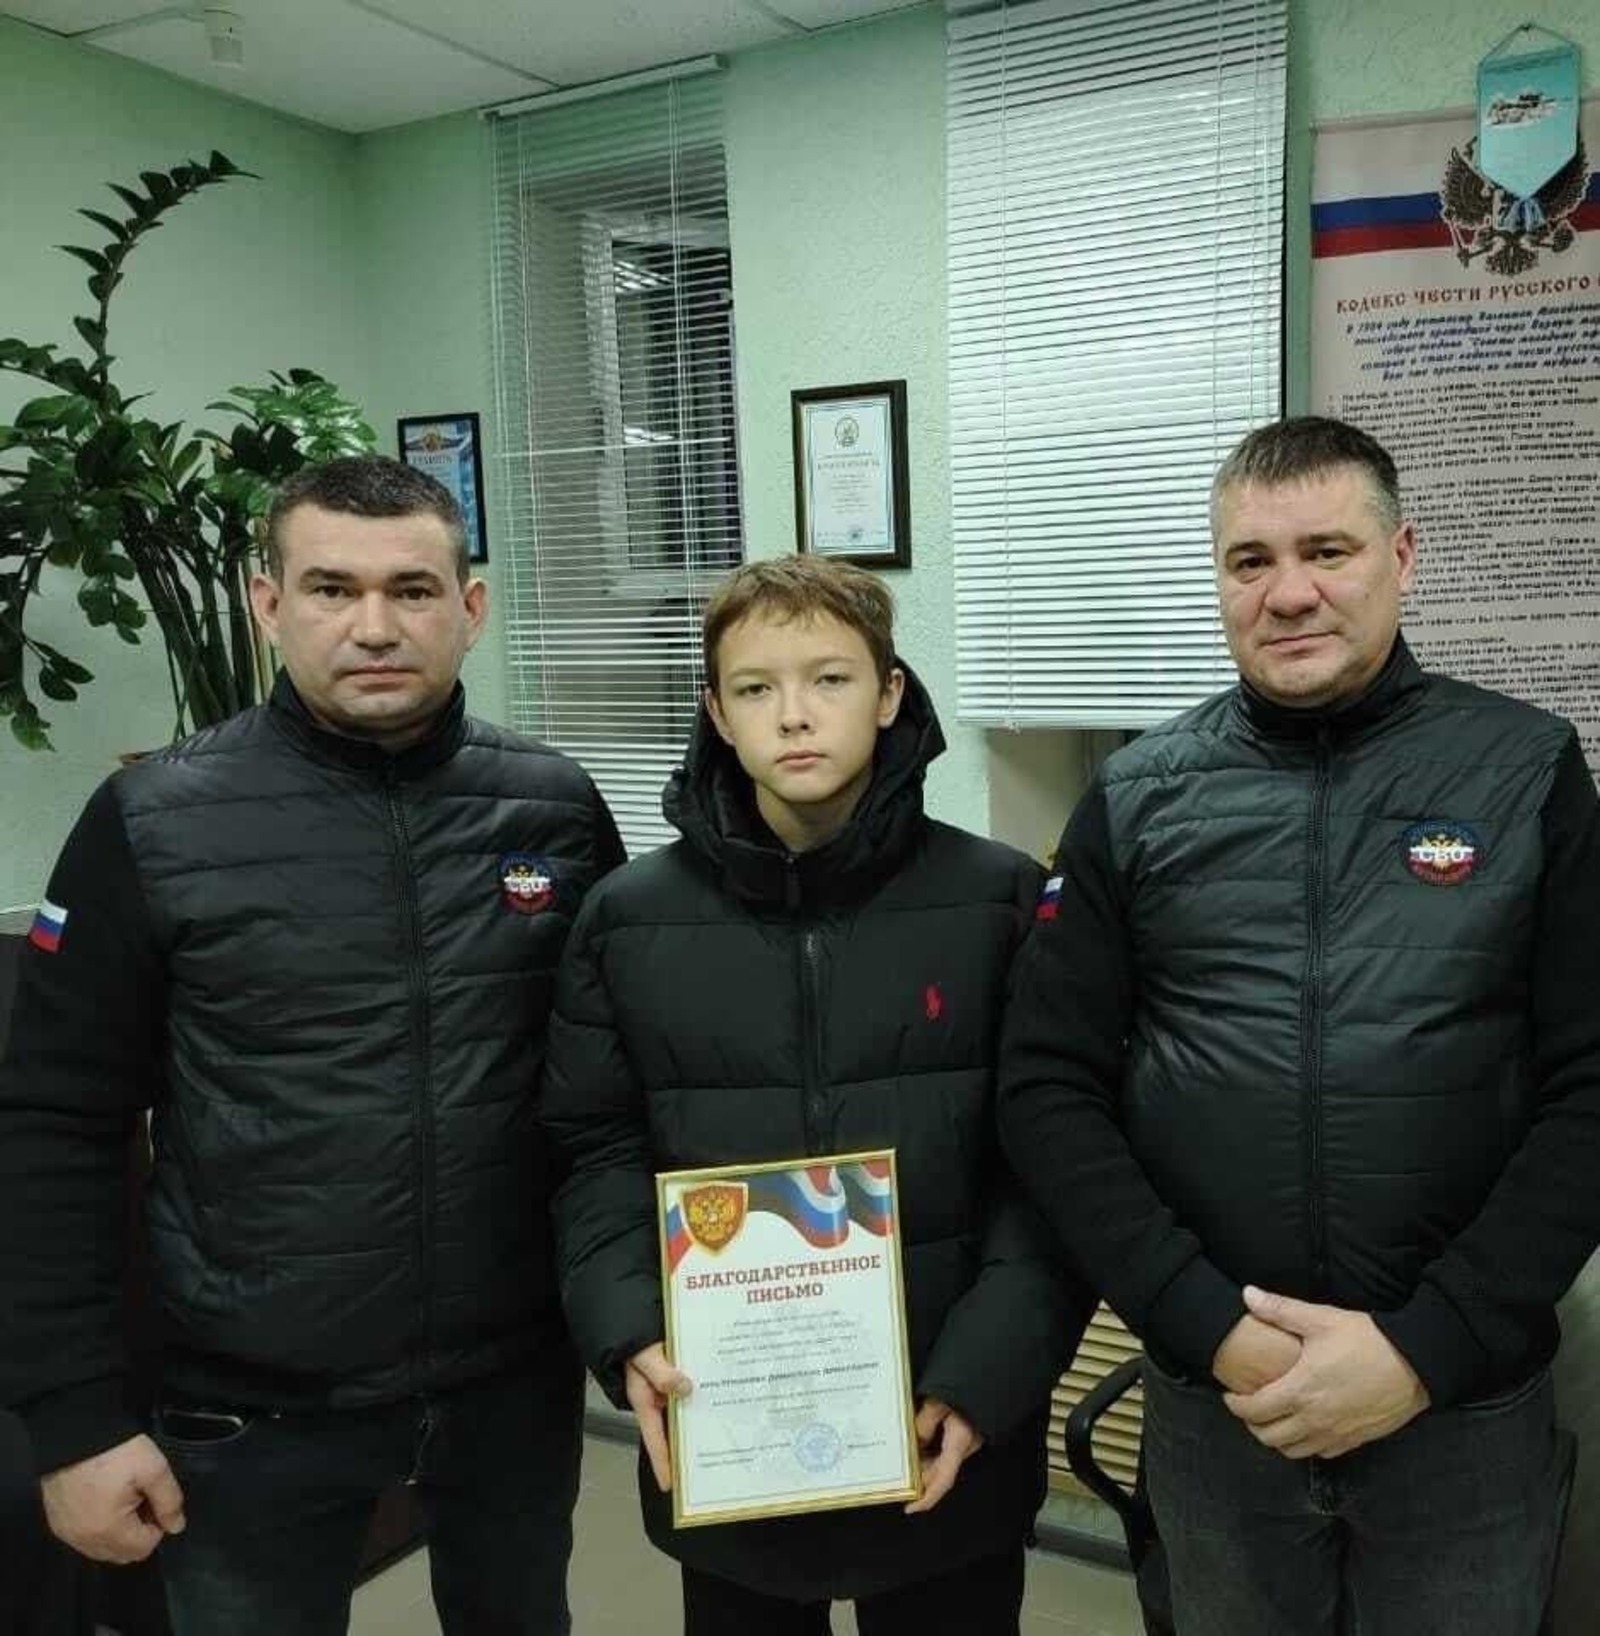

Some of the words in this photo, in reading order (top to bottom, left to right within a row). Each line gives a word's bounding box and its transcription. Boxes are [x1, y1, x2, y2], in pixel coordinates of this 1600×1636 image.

[1415, 286, 1480, 305] ЧЕСТИ
[1489, 276, 1590, 301] РУССКОГО
[686, 1254, 881, 1291] БЛАГОДАРСТВЕННОЕ
[747, 1283, 824, 1305] ПИСЬМО
